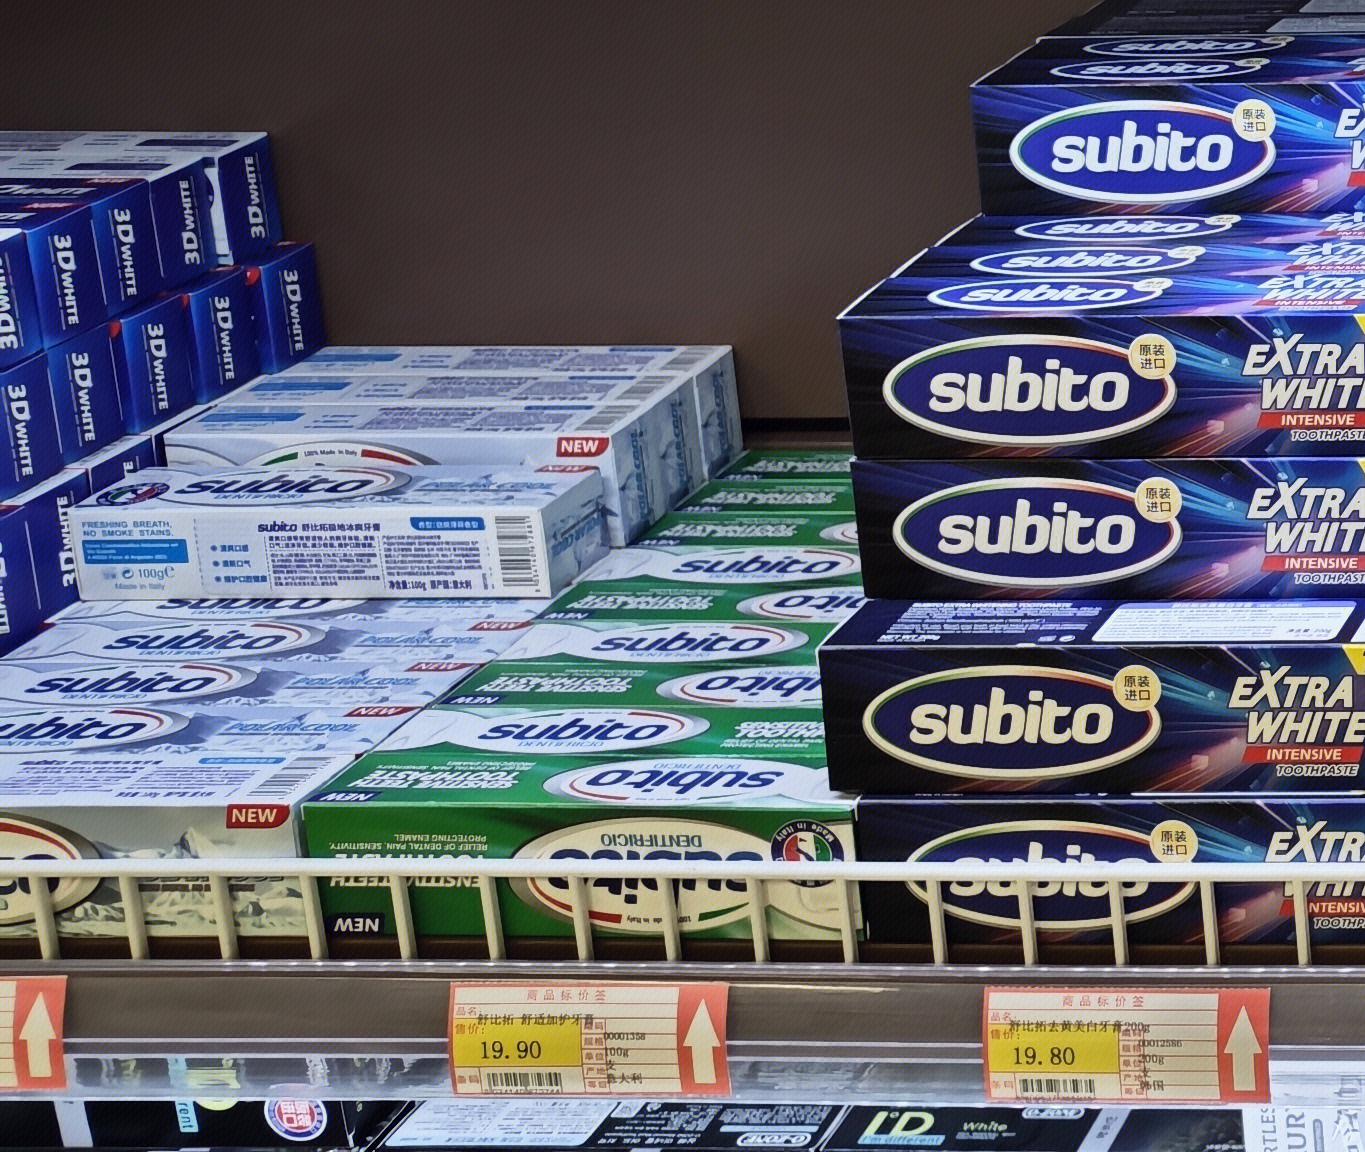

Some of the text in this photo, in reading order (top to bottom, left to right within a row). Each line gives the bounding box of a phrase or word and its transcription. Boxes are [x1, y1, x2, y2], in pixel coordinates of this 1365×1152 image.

[1242, 108, 1265, 120] 原装
[1242, 122, 1266, 133] 进口
[1052, 120, 1232, 173] subito
[245, 155, 263, 201] WHITE
[560, 439, 599, 453] NEW
[257, 522, 298, 533] subito
[1229, 666, 1354, 708] EXTRA
[909, 688, 1112, 744] subito
[232, 807, 277, 823] NEW
[600, 833, 701, 846] DENTIFRICIO
[336, 916, 380, 932] NEW
[481, 1041, 542, 1059] 19.90
[1014, 1047, 1075, 1065] 19.80
